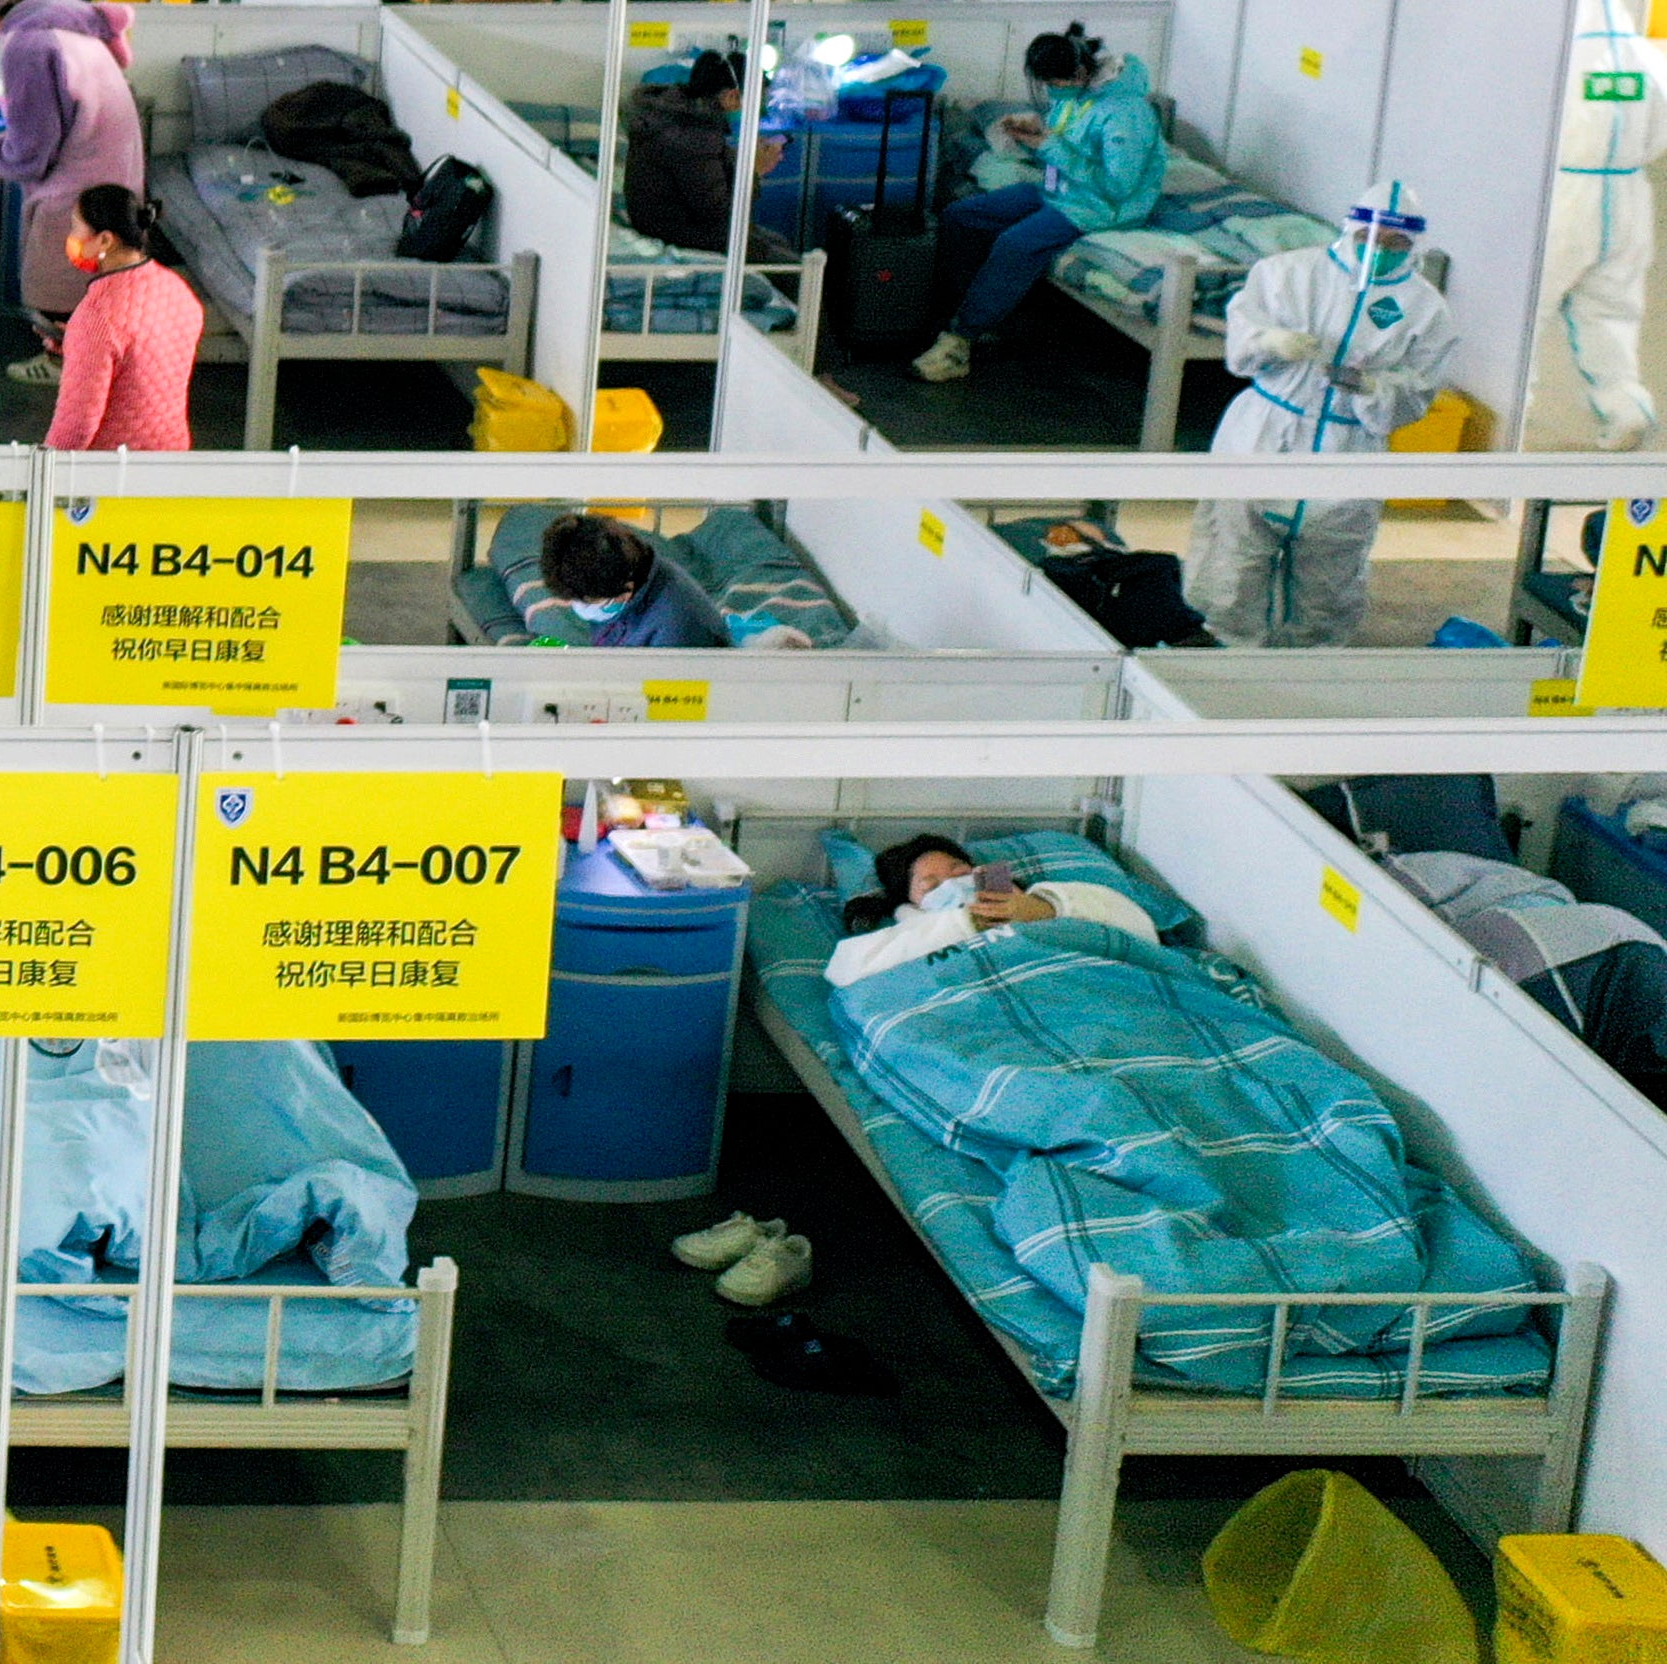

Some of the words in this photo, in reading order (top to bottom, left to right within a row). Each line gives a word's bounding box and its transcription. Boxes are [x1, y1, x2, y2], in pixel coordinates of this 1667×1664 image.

[78, 543, 140, 578] N4
[152, 543, 314, 578] B4-014
[101, 604, 280, 629] 感谢理解和配合
[112, 639, 264, 662] 祝你早日康复
[231, 845, 304, 885] N4
[320, 845, 520, 885] B4-007
[263, 919, 477, 947] 感谢理解和配合
[276, 960, 459, 987] 祝你早日康复
